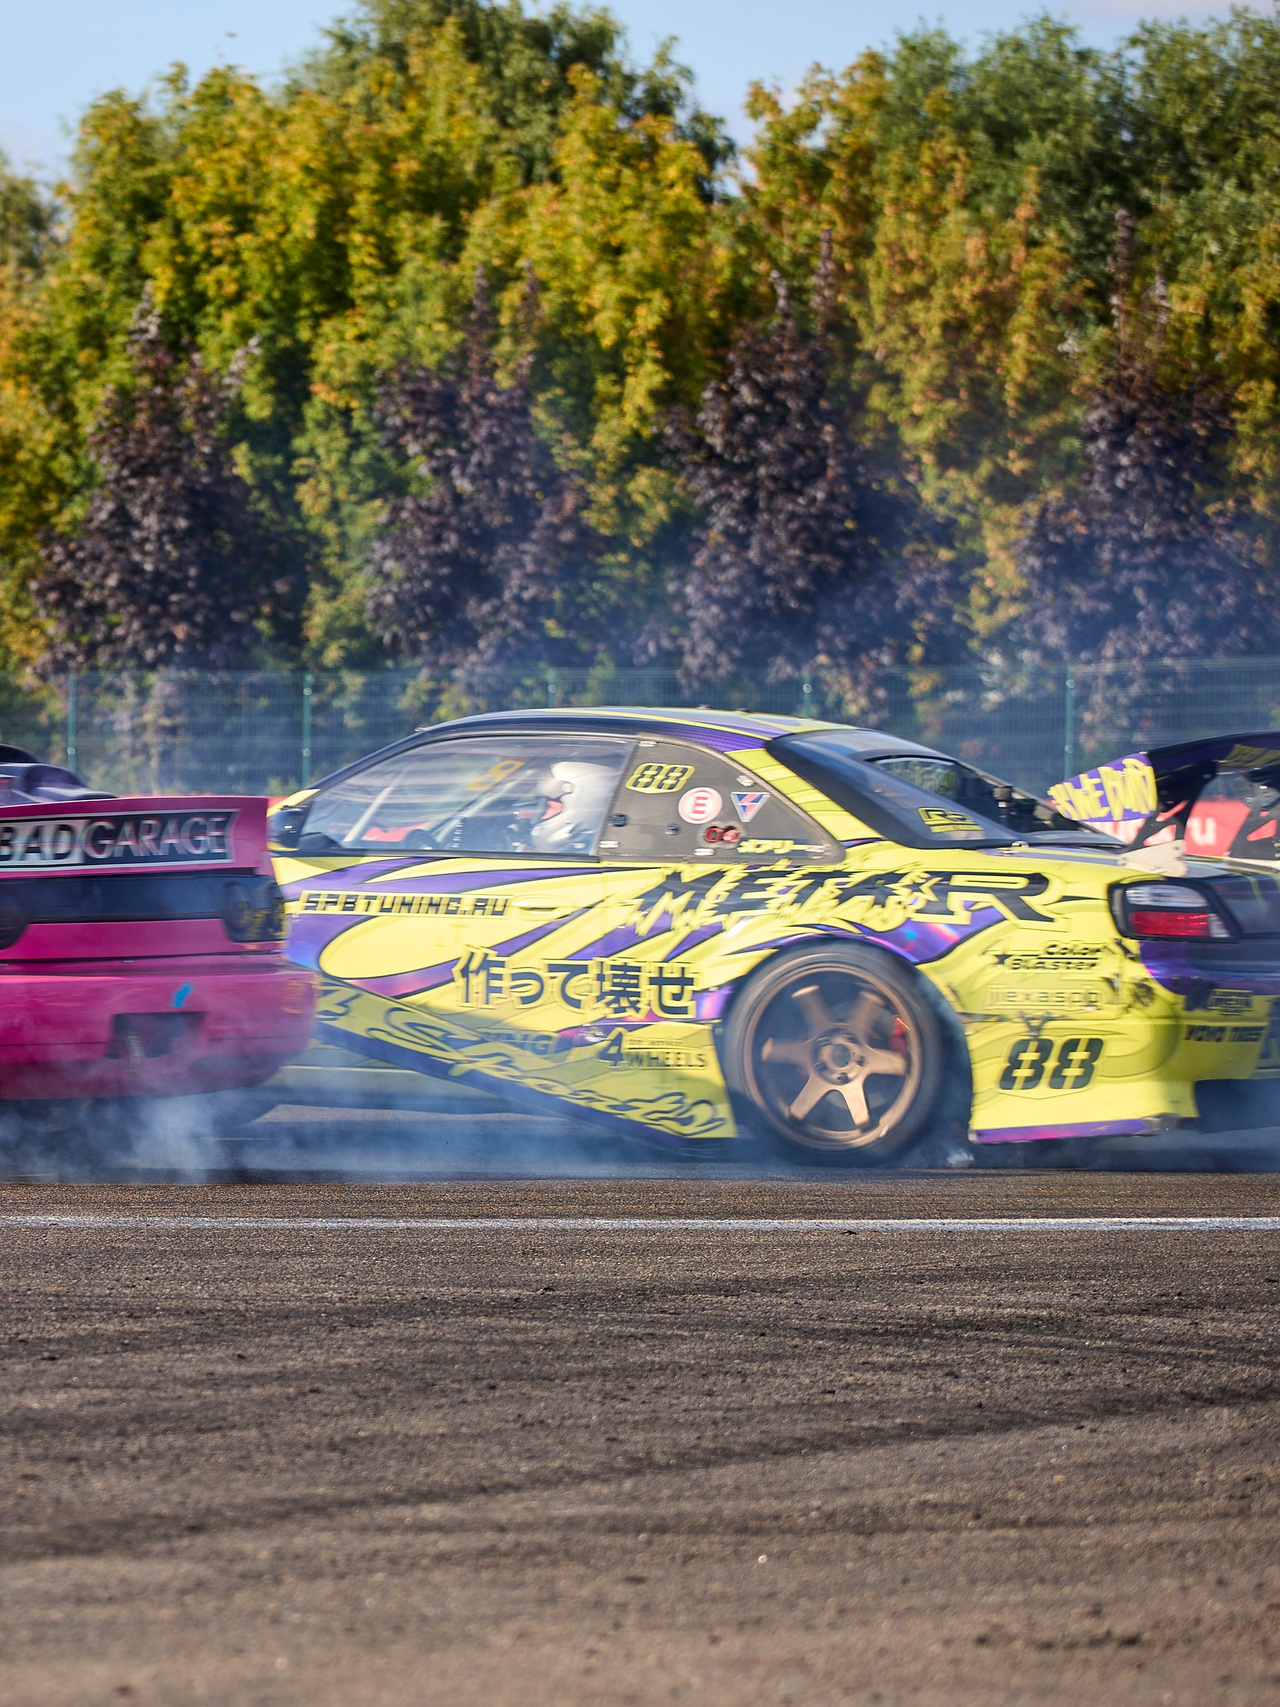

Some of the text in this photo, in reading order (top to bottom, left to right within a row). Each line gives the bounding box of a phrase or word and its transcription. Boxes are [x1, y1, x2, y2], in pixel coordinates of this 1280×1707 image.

[632, 764, 689, 791] 88
[82, 816, 228, 859] GARAGE
[303, 892, 509, 916] SPBTUNING.RU
[456, 950, 698, 1017] 作って壊せ
[597, 1031, 625, 1067] 4
[624, 1050, 707, 1068] WHEELS
[999, 1038, 1104, 1091] 88
